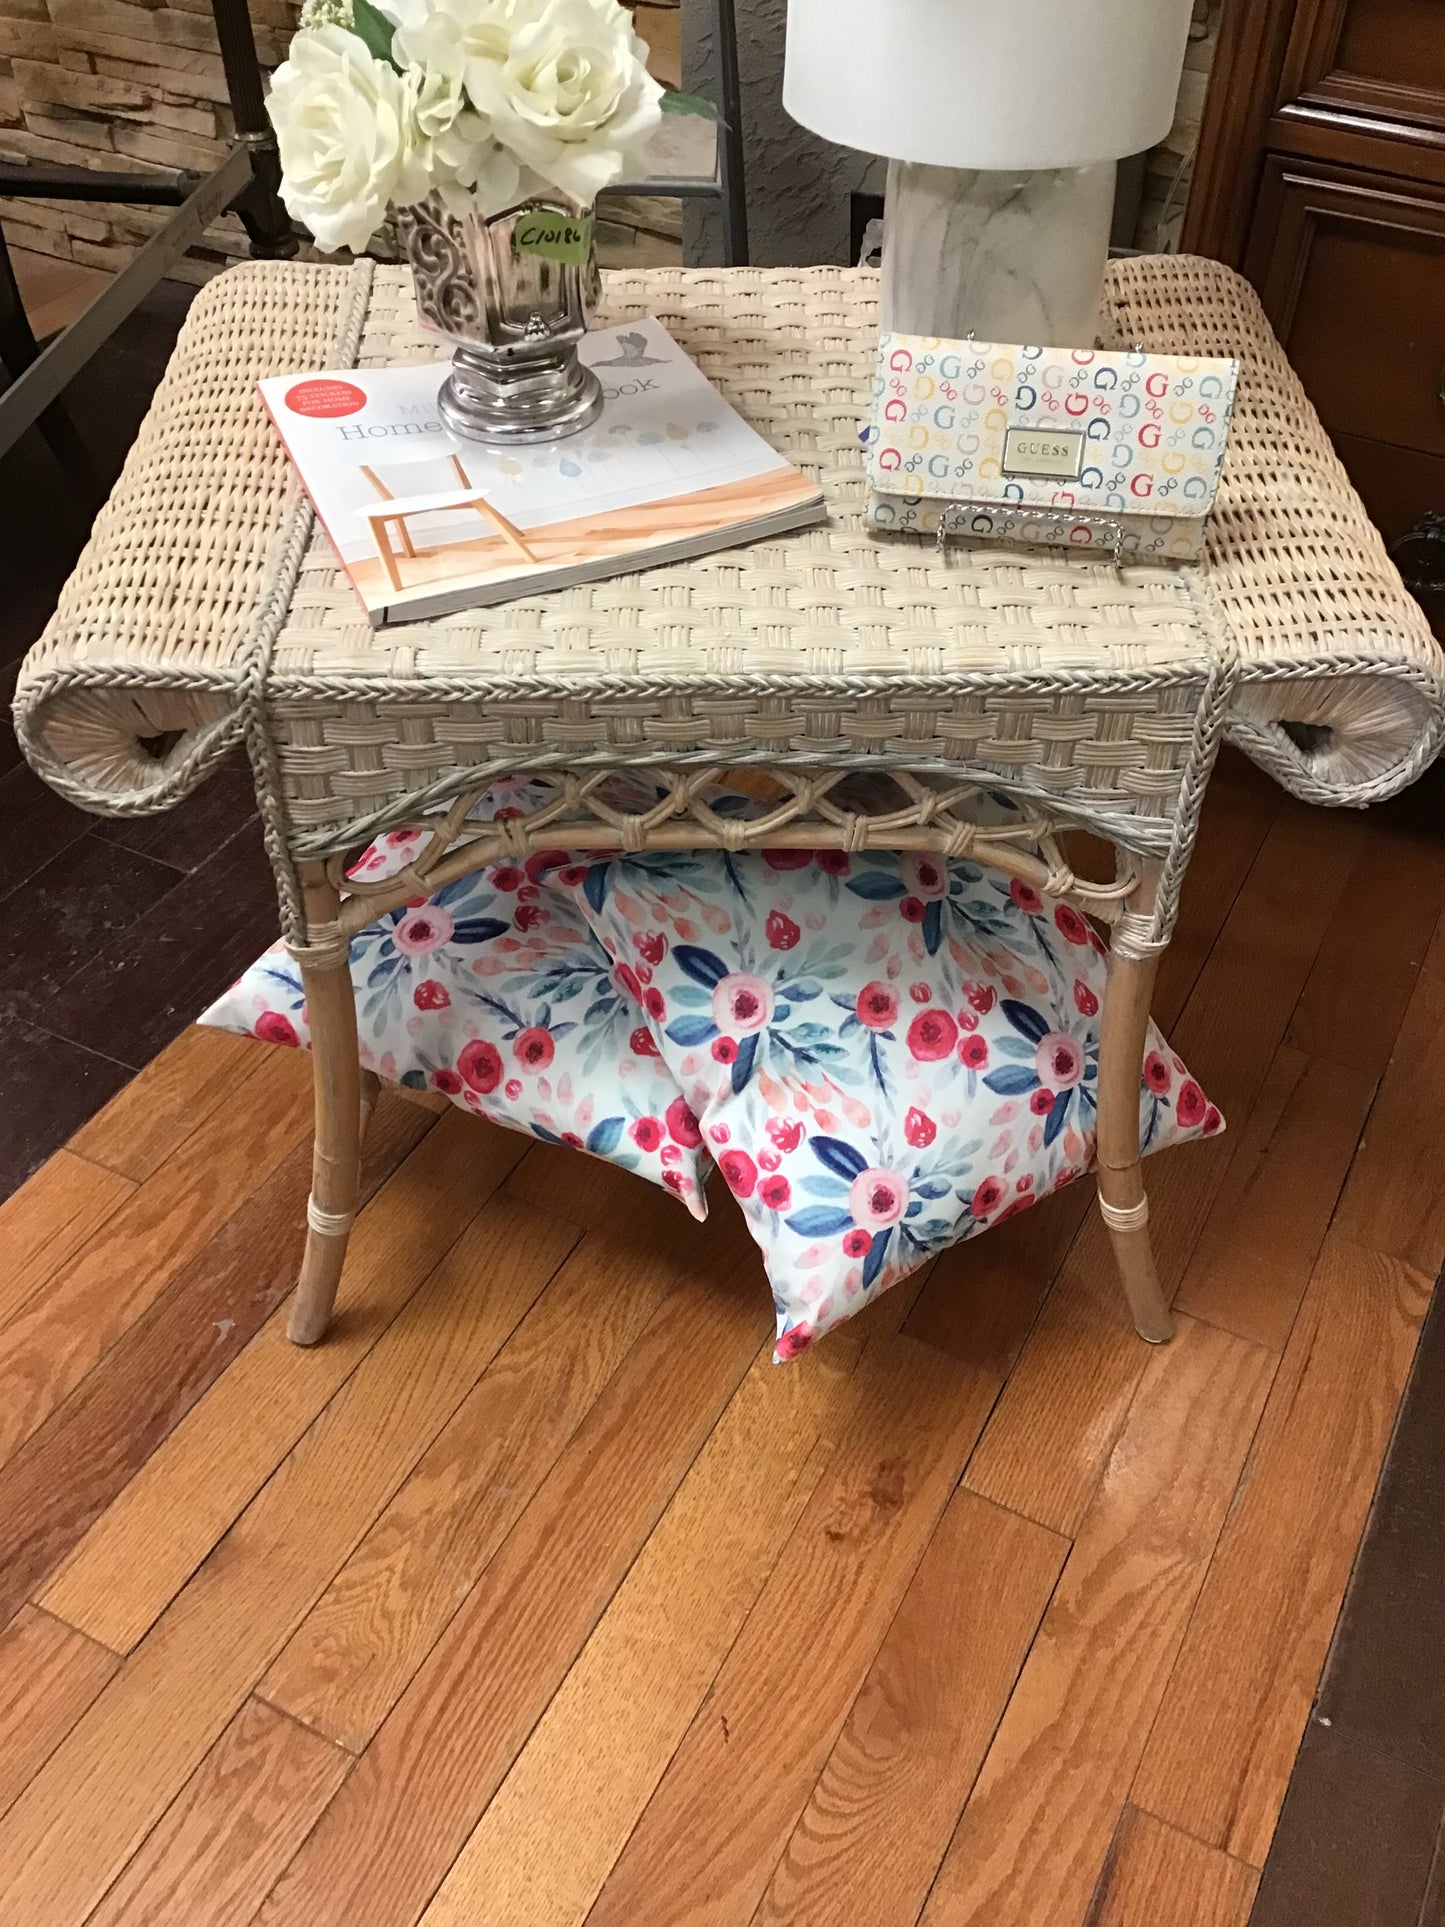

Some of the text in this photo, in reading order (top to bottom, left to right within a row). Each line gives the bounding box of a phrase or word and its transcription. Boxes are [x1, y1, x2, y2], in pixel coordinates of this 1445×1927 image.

[520, 227, 581, 246] C10186
[336, 379, 661, 440] Home ook
[1017, 442, 1069, 457] GUESS
